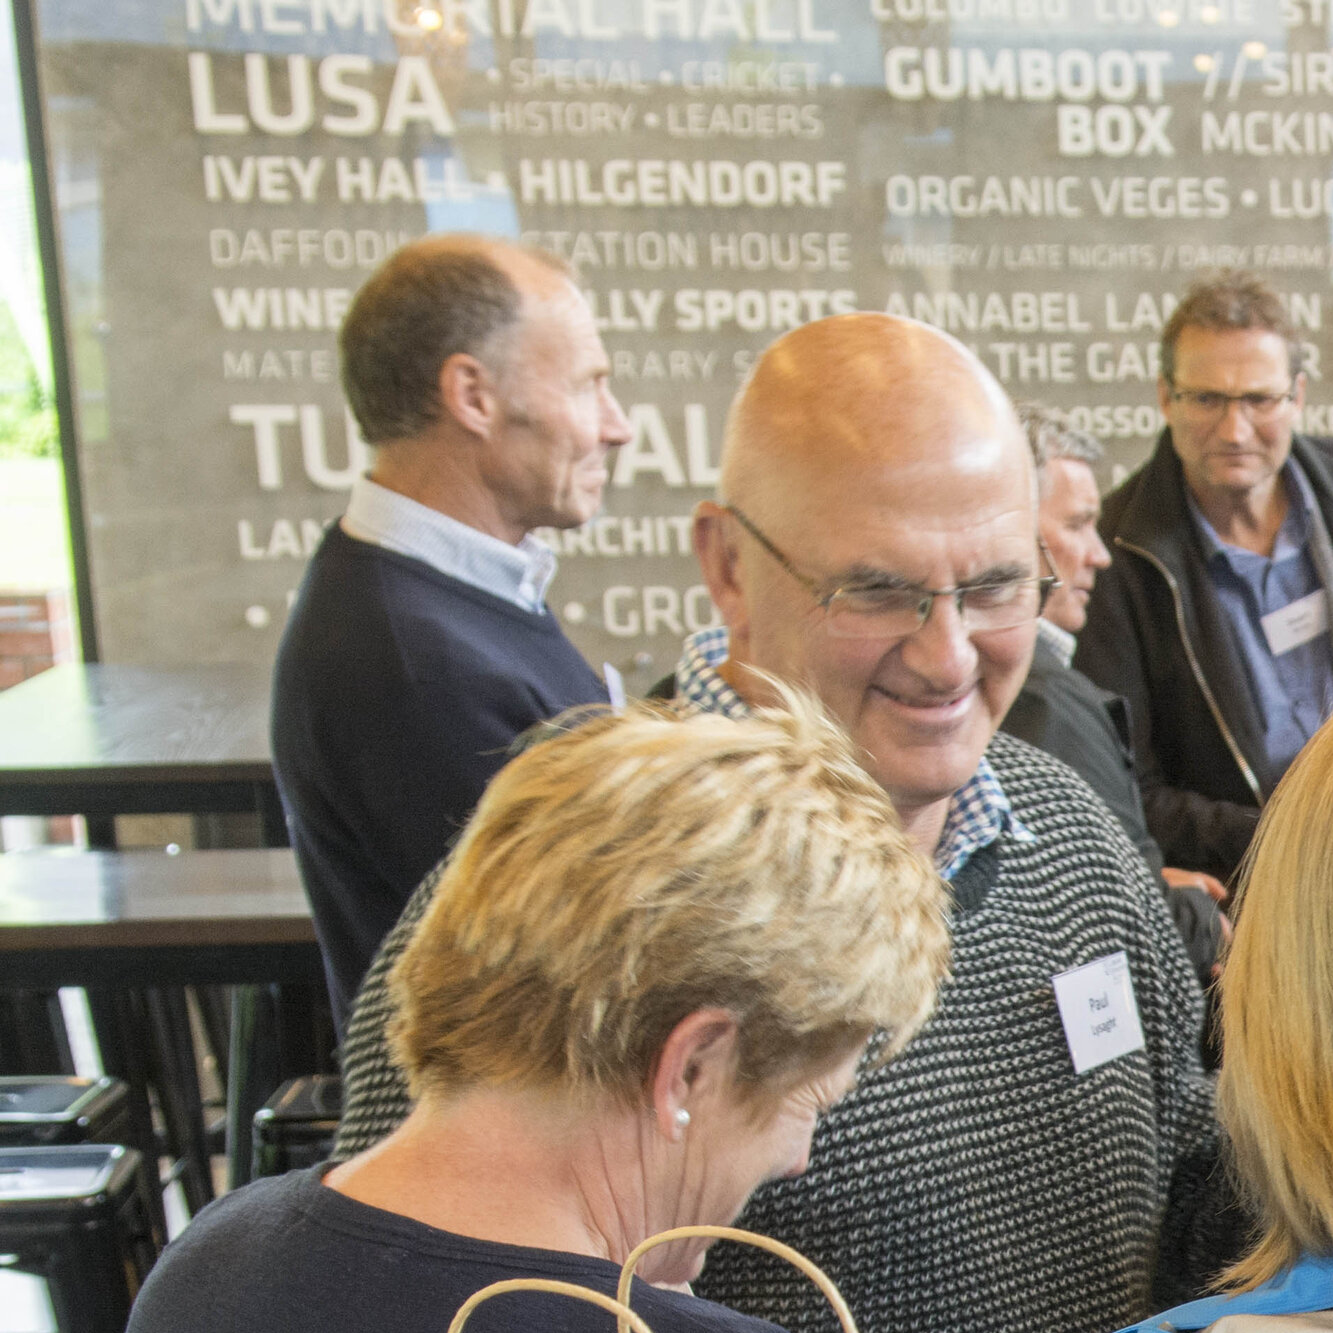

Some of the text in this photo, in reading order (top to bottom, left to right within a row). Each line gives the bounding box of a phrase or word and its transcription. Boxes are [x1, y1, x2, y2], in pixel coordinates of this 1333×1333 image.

[186, 0, 839, 42] MEMORIAL HALL
[187, 51, 454, 136] LUSA
[509, 58, 820, 96] SPECIAL CRICKET
[884, 46, 1173, 101] GUMBOOT
[488, 100, 825, 139] HISTORY LEADERS
[1056, 104, 1175, 157] BOX
[203, 155, 847, 208] IVEY HALL HILGENDORF
[886, 175, 1084, 219] ORGANIC
[1091, 176, 1231, 219] VEGES
[709, 232, 852, 271] HOUSE
[1003, 244, 1064, 271] LATE
[675, 288, 858, 332] SPORTS
[988, 341, 1076, 384] THE
[1088, 990, 1109, 1013] Paul
